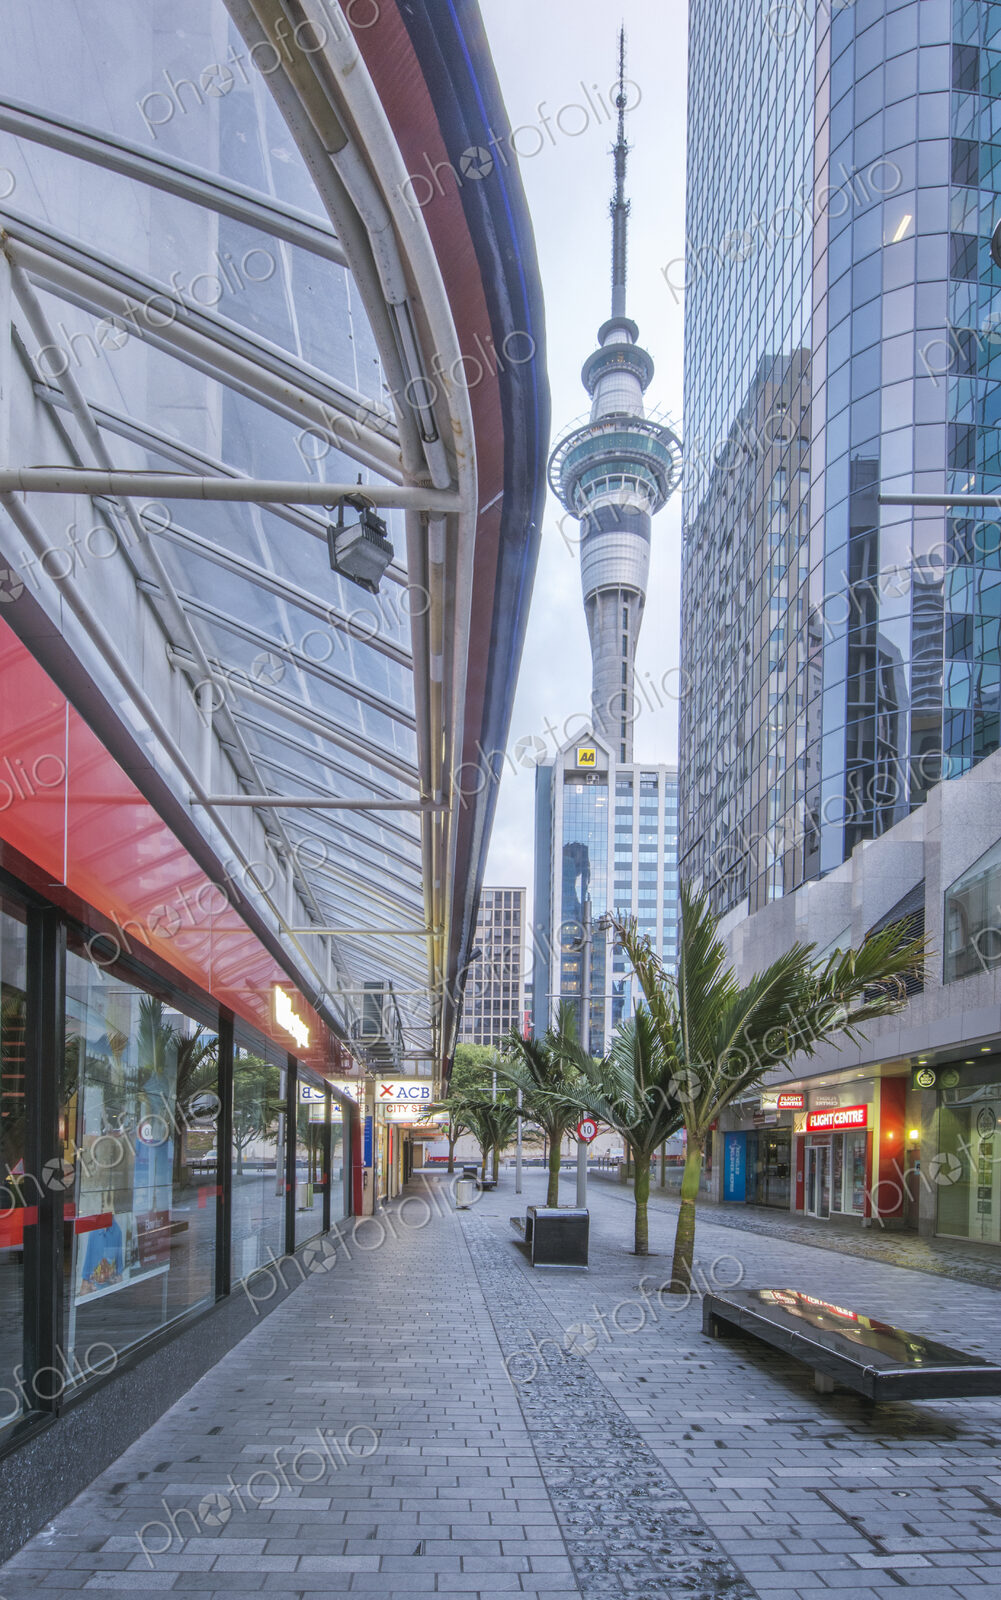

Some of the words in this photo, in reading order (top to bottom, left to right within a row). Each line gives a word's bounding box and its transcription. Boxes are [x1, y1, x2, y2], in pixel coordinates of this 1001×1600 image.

[580, 752, 594, 762] AA
[396, 1086, 430, 1099] ACB
[386, 1104, 409, 1113] CITY
[810, 1113, 833, 1127] FLIGHT
[834, 1109, 864, 1124] CENTRE
[583, 1125, 592, 1135] 10
